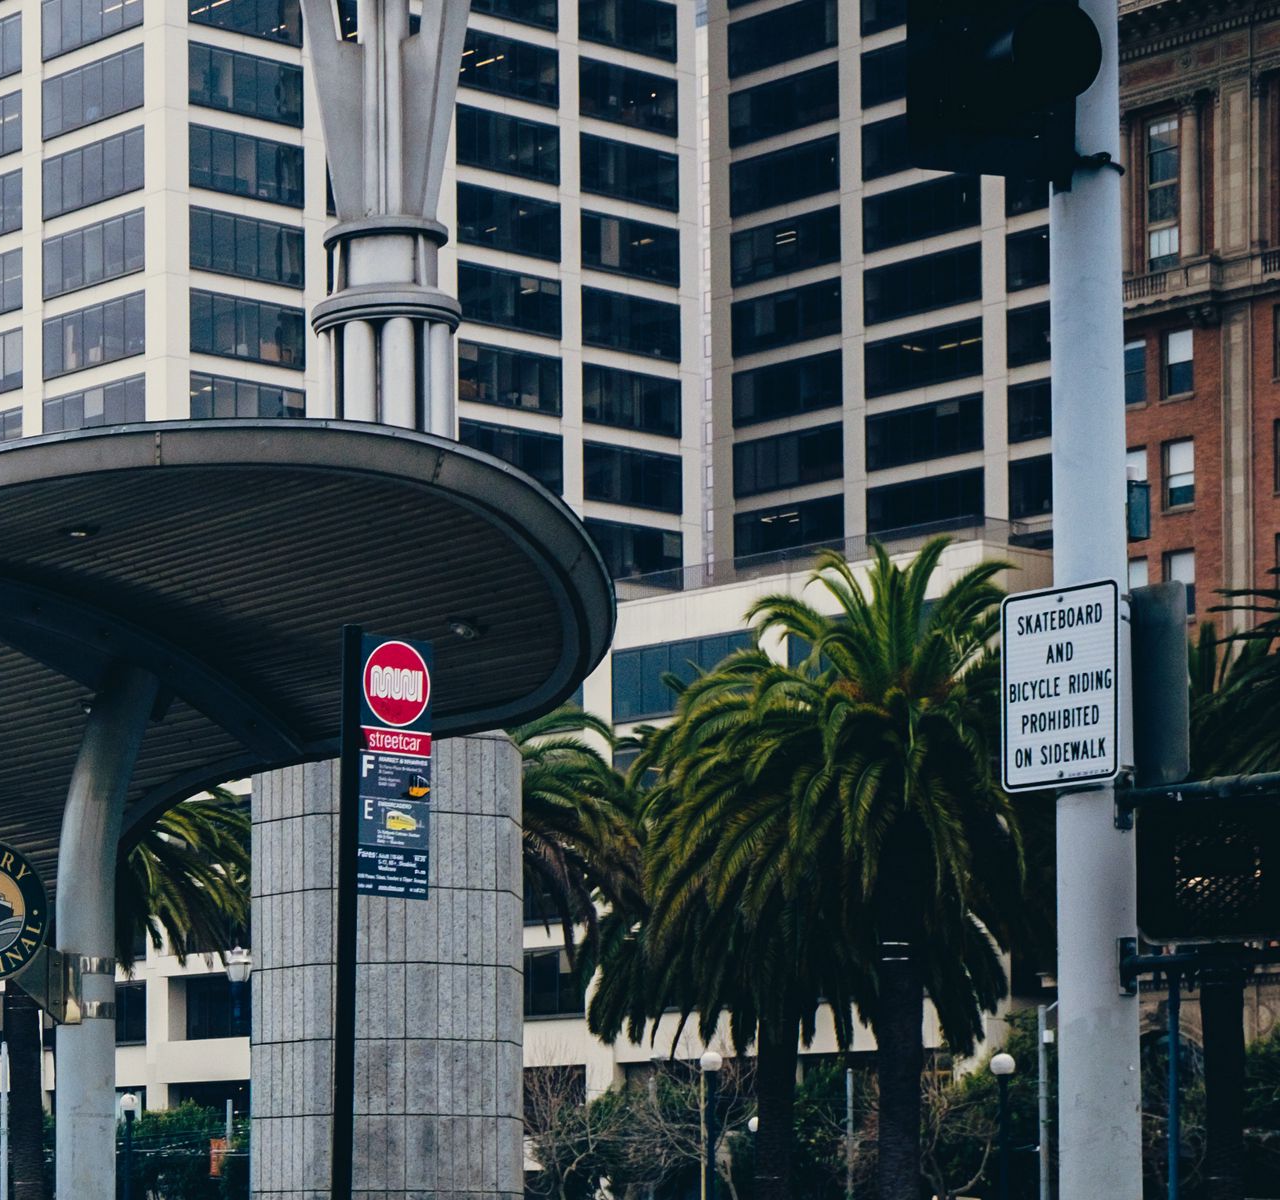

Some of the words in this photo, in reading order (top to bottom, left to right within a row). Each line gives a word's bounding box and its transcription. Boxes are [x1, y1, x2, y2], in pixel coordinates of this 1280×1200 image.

[1017, 603, 1102, 636] SKATEBOARD
[1046, 641, 1074, 664] AND
[1009, 676, 1060, 703] BICYCLE
[1069, 669, 1112, 694] RIDING
[1021, 704, 1100, 735] PROHIBITED
[369, 731, 422, 752] streetcar
[1015, 747, 1033, 768] ON
[1040, 737, 1106, 765] SIDEWALK
[362, 755, 375, 777] F
[364, 799, 374, 820] E
